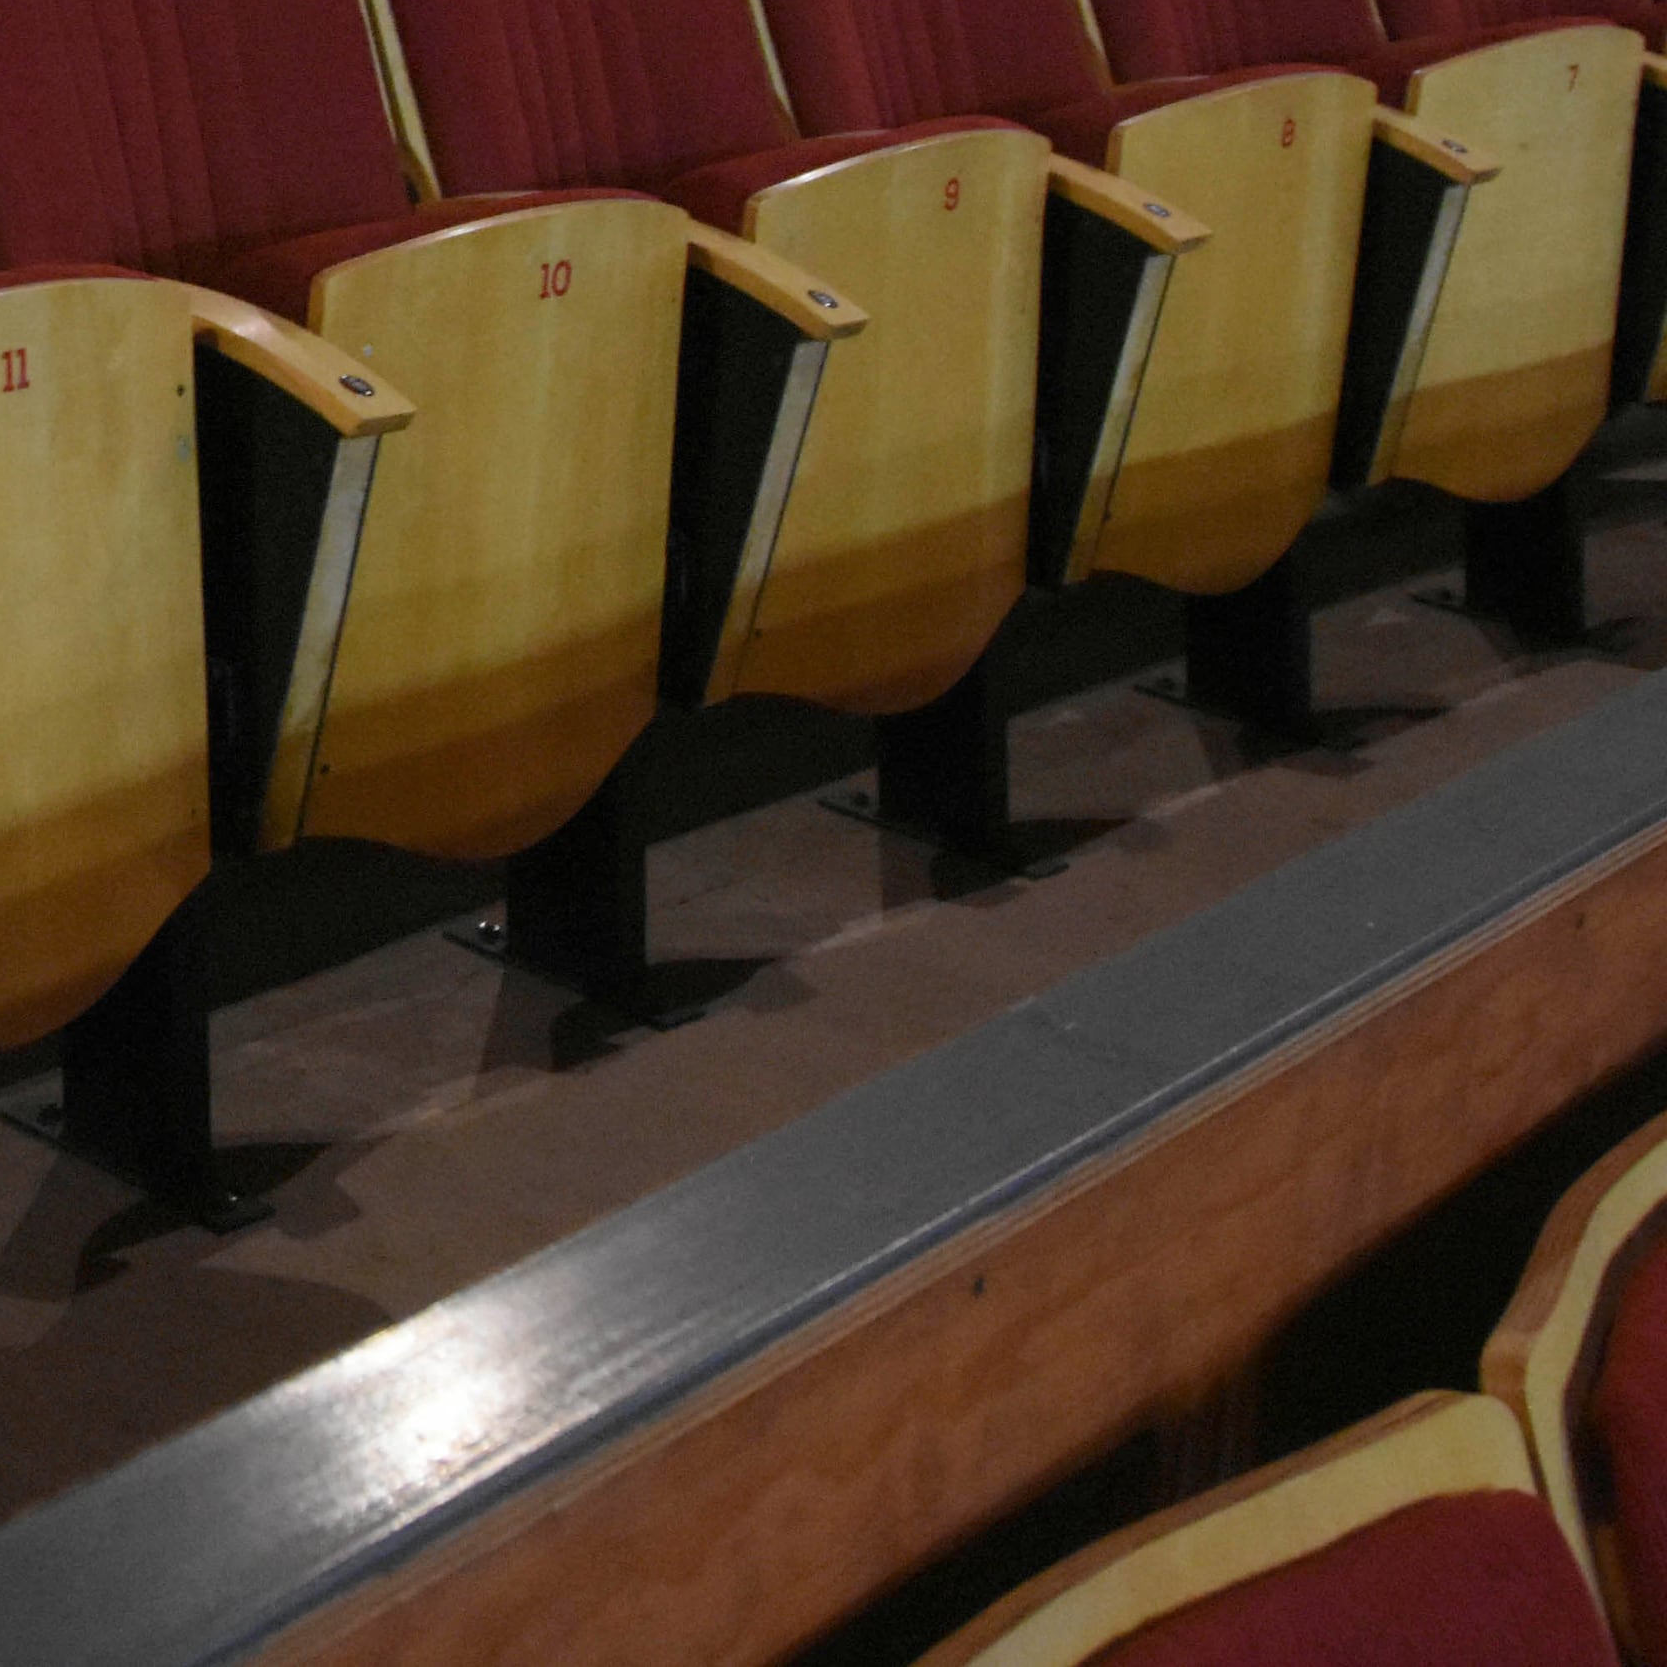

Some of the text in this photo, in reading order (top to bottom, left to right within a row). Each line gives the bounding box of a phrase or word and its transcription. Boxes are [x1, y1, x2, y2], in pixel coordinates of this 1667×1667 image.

[1280, 116, 1298, 148] 8
[942, 176, 962, 212] 9
[538, 260, 573, 299] 10
[2, 347, 31, 393] 11
